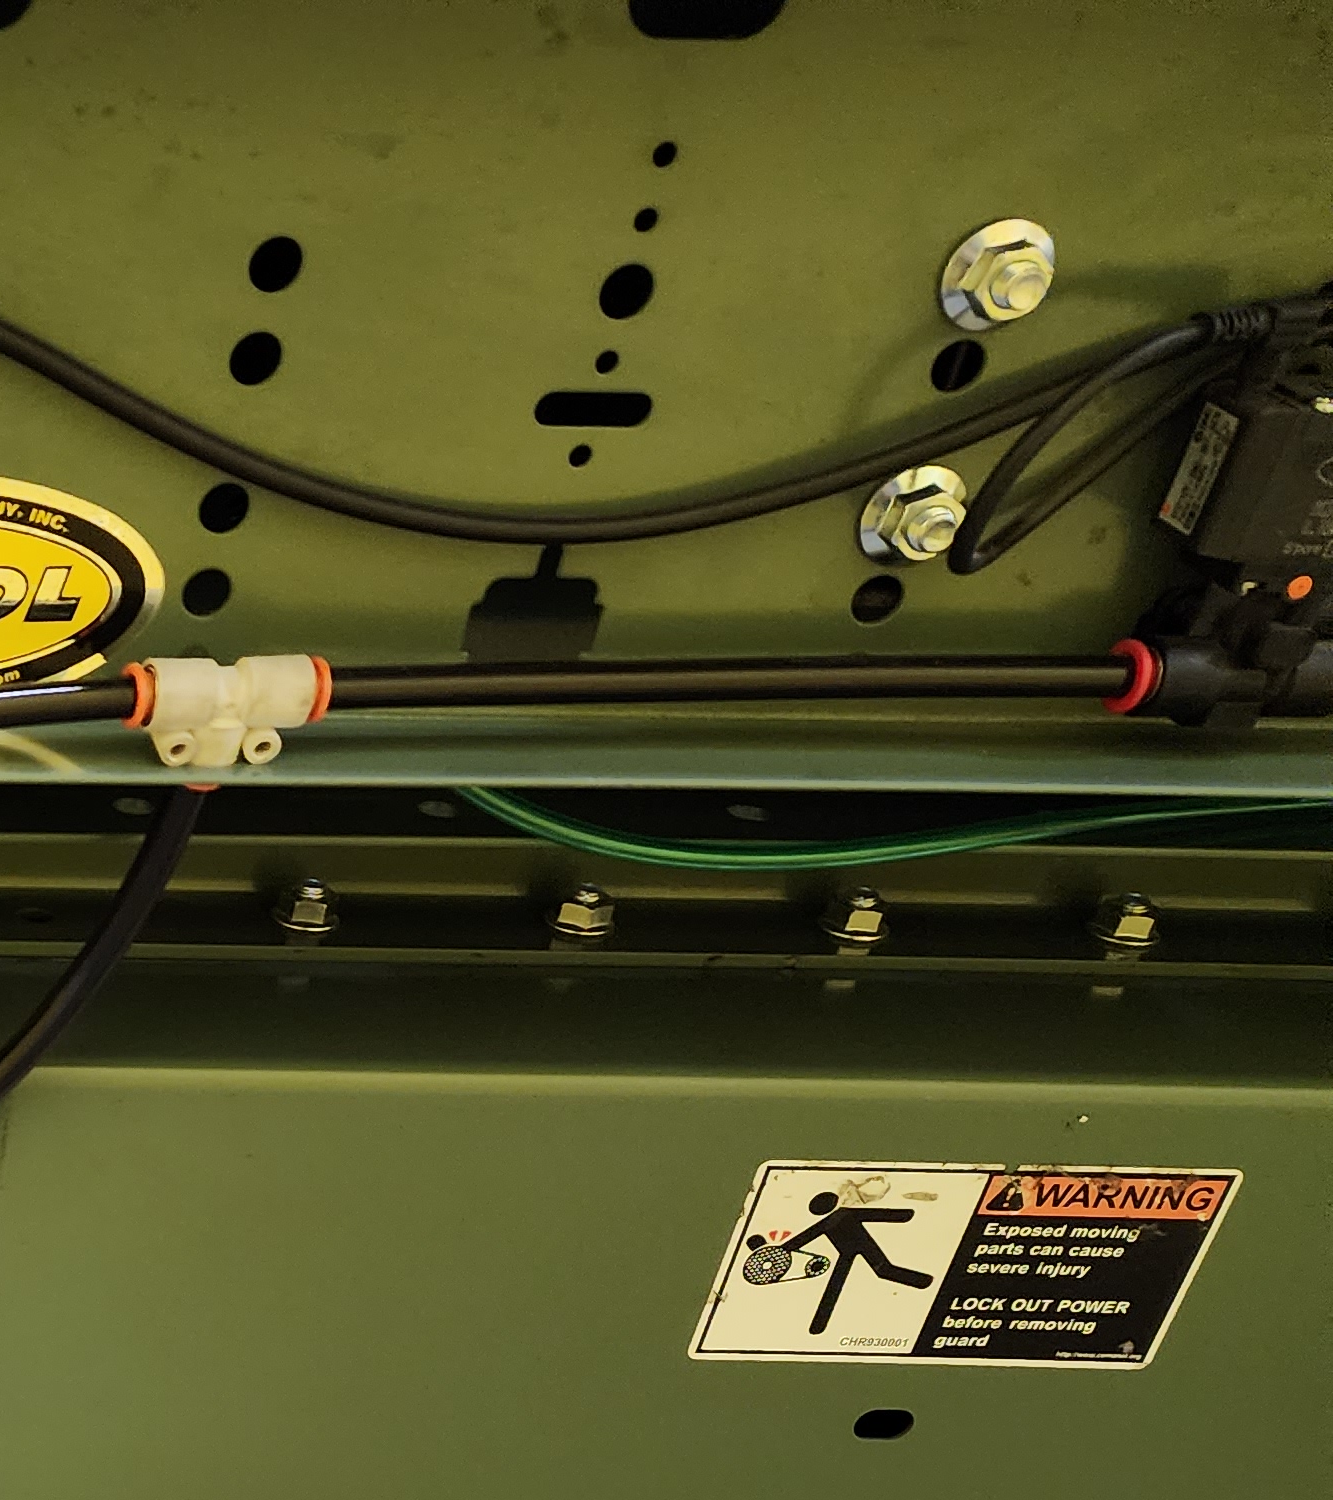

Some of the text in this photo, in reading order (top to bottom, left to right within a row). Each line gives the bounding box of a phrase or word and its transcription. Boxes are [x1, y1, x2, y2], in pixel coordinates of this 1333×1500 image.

[29, 508, 69, 532] INC.
[1033, 1183, 1215, 1212] WARNING
[983, 1222, 1141, 1242] Exposed moving
[974, 1242, 1125, 1259] parts can cause
[966, 1262, 1091, 1279] severe injury
[950, 1297, 1130, 1315] LOCK OUT POWER
[942, 1315, 1097, 1335] before removing
[840, 1337, 909, 1347] CHR930001
[933, 1334, 991, 1350] guard
